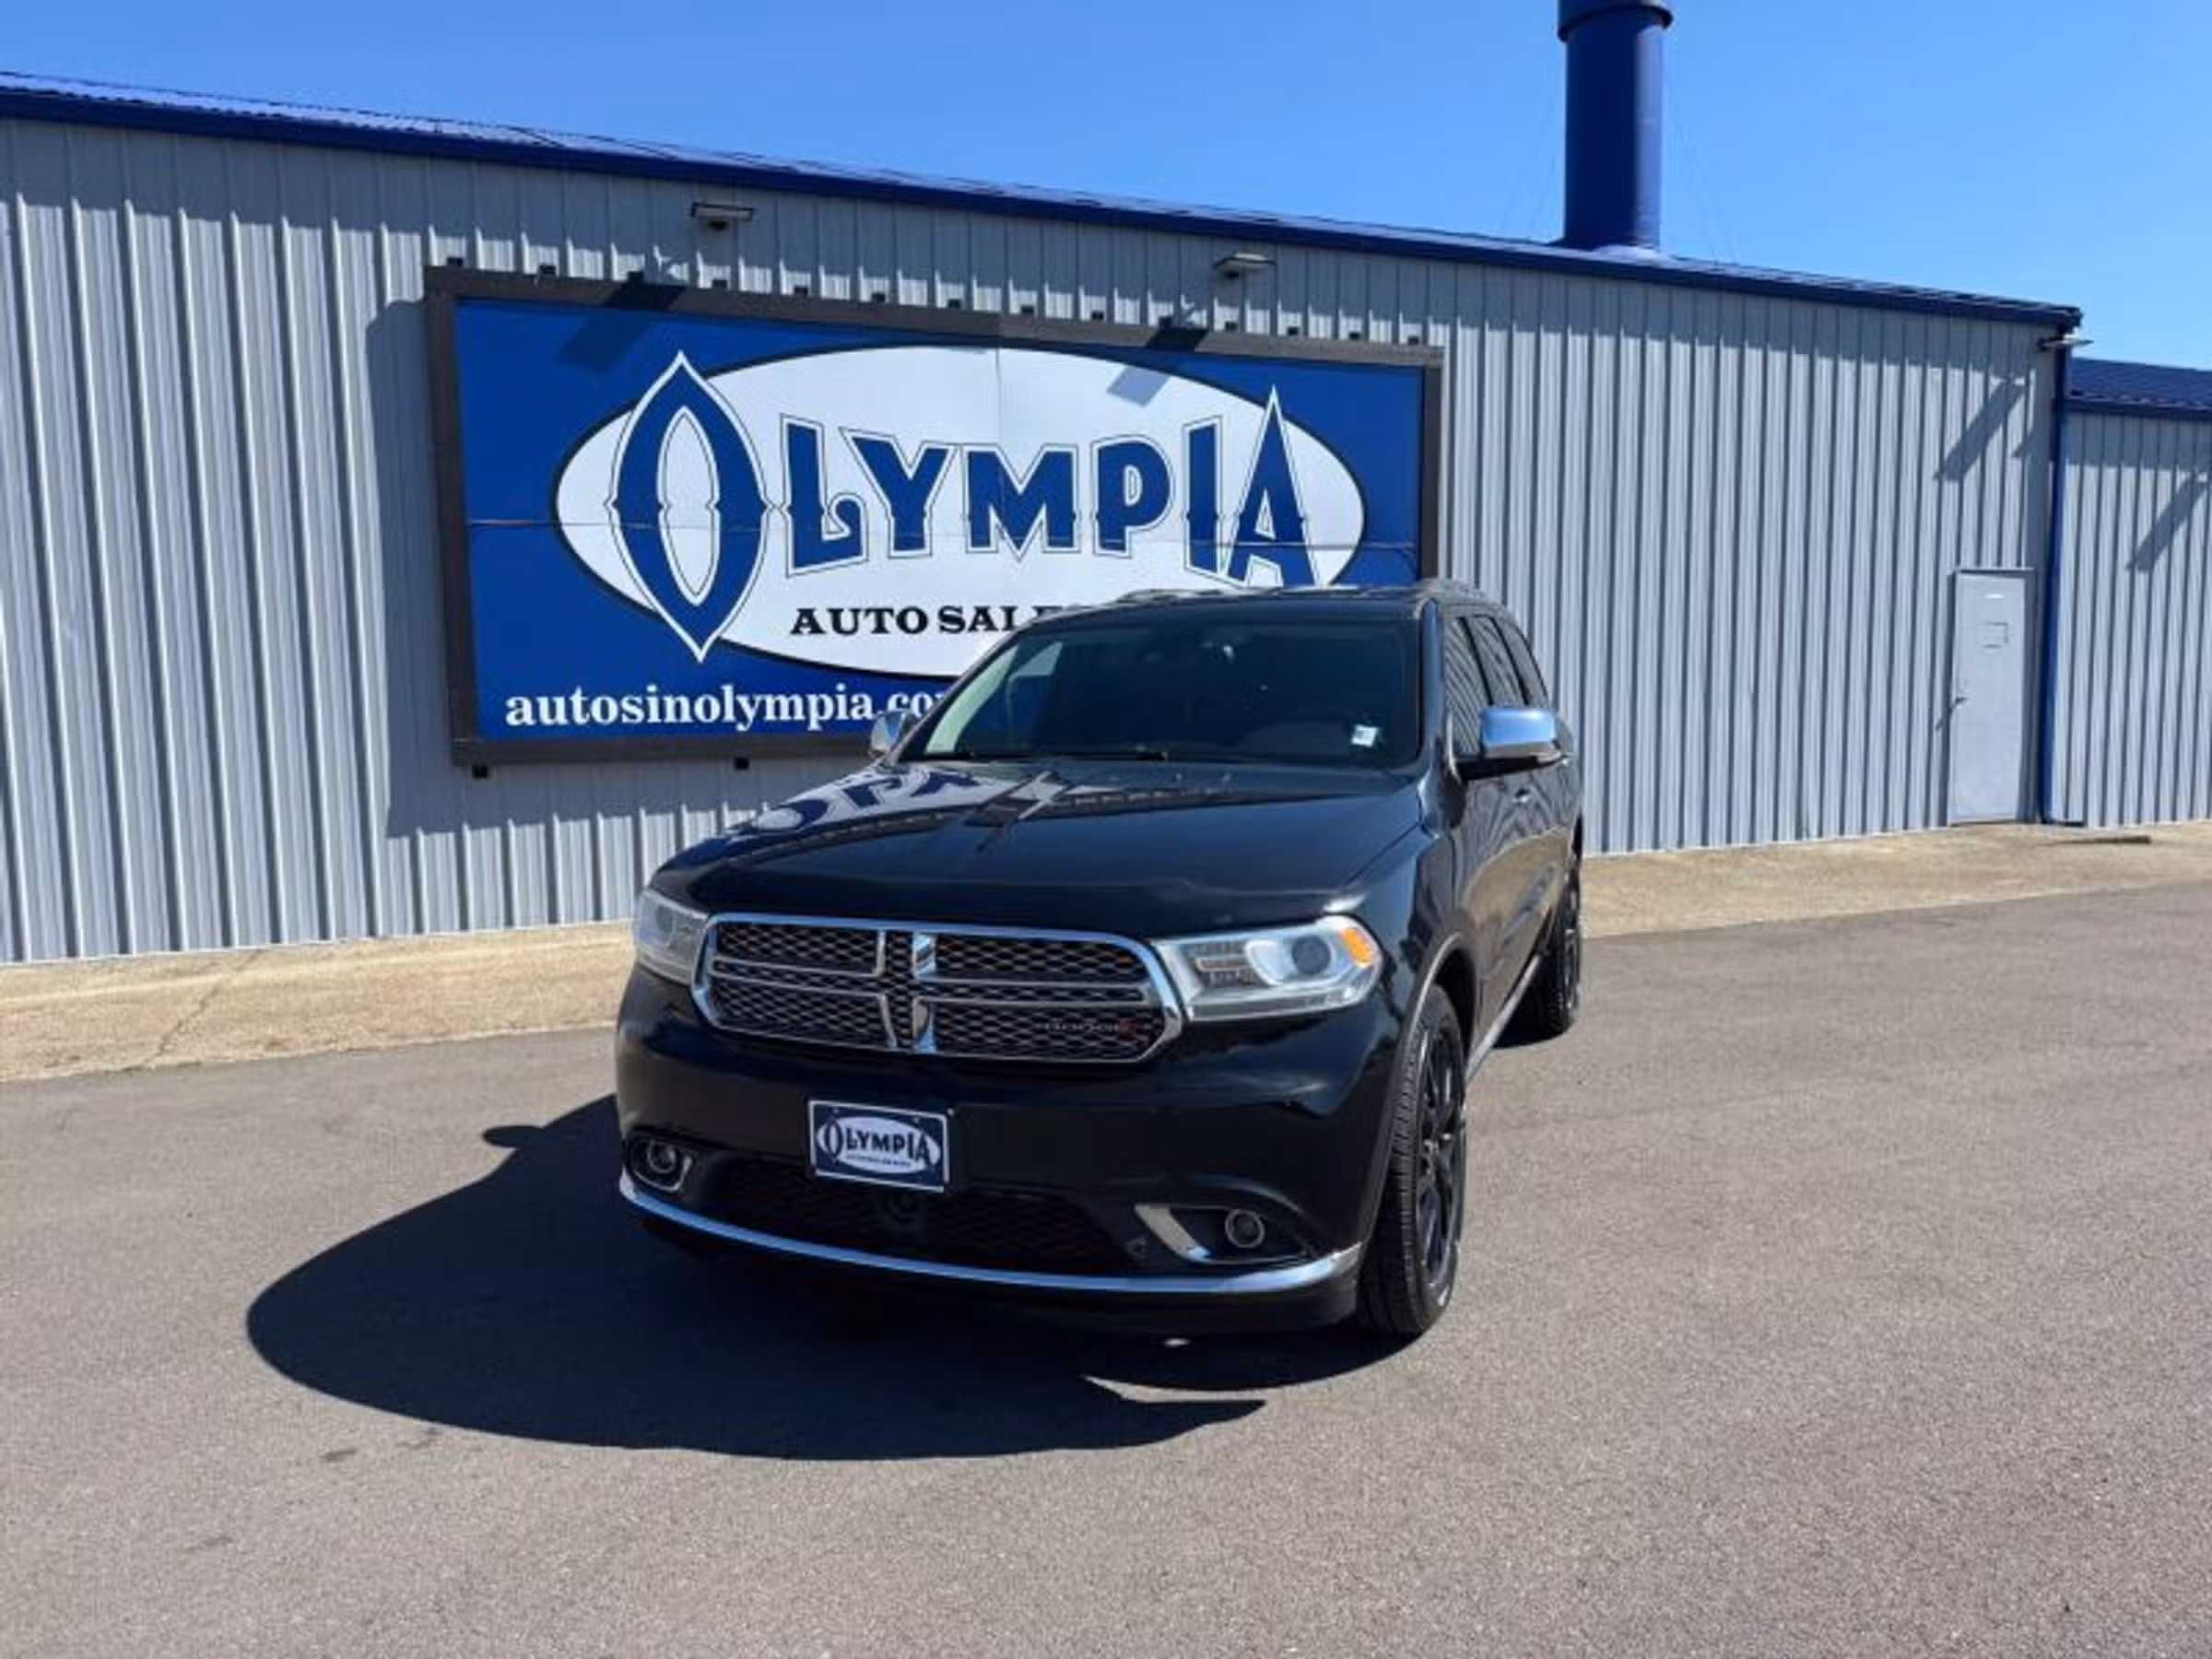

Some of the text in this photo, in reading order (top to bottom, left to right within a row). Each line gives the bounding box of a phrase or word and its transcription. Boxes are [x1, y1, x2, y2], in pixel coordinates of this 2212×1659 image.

[605, 350, 1320, 663] OLYMPIA
[790, 605, 1093, 635] AUTO SAL
[505, 683, 944, 731] autosinolympiaco
[823, 1117, 934, 1168] OLYMPIA
